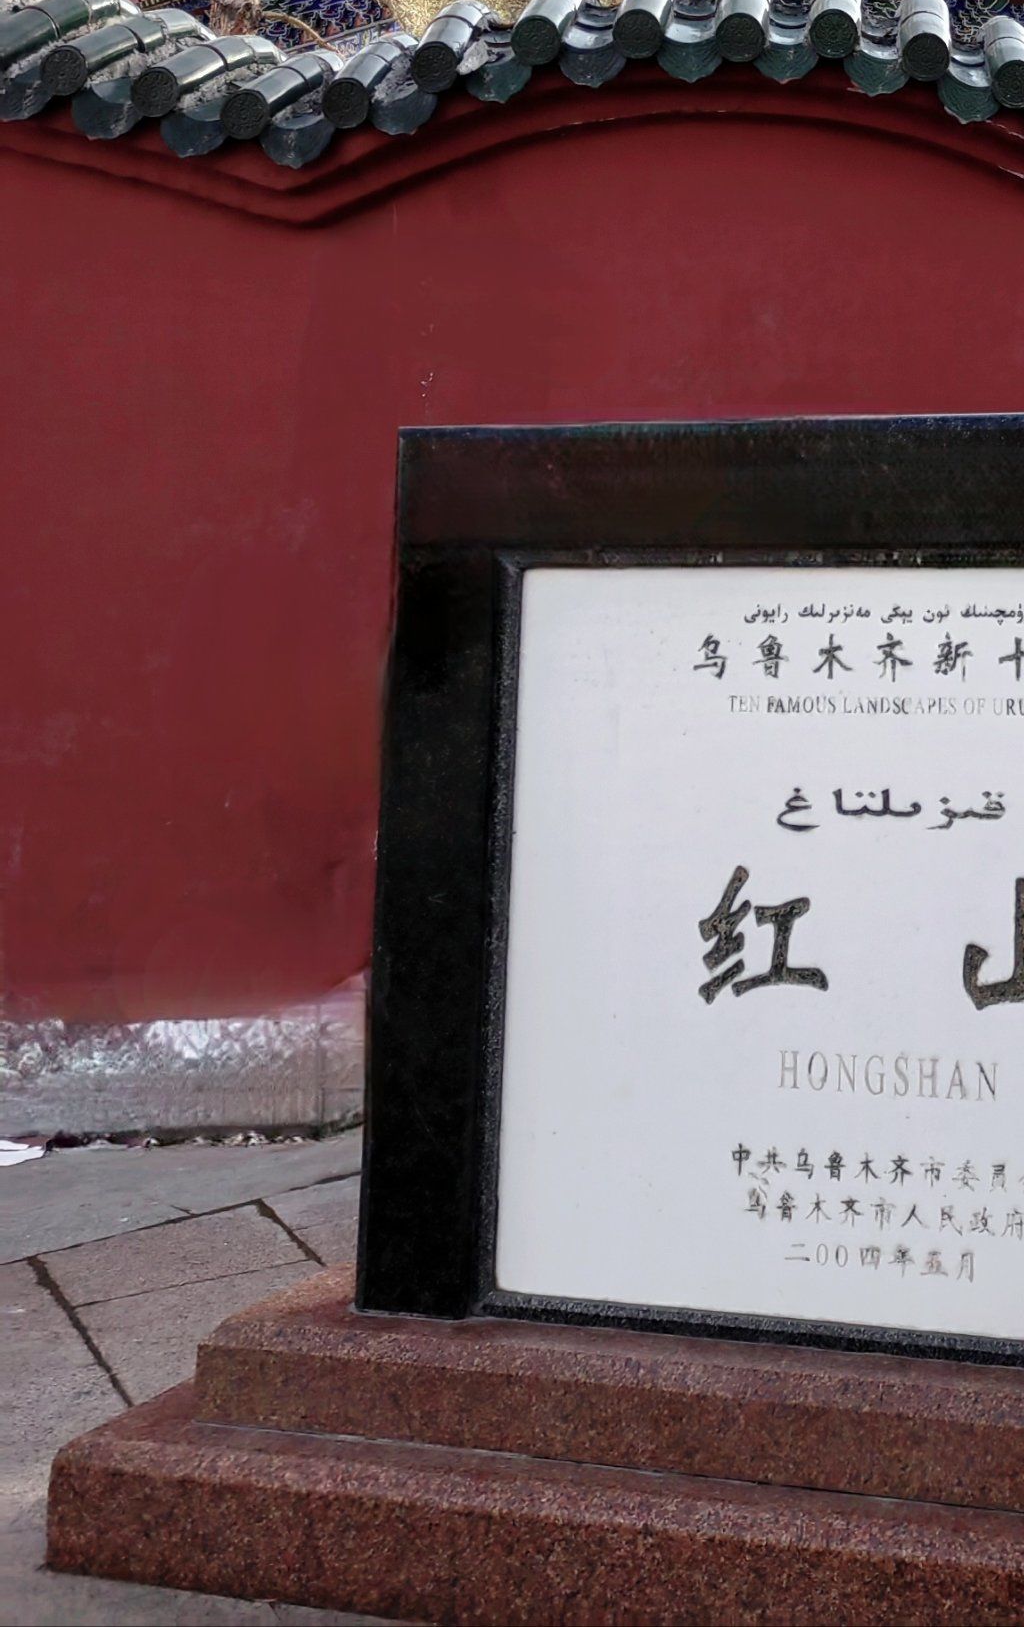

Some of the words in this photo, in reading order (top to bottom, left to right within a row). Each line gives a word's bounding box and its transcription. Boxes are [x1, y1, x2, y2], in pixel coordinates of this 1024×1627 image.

[728, 694, 761, 714] TEN
[767, 695, 837, 715] FAMOUS
[842, 695, 958, 716] LANDSCAPES
[963, 696, 987, 716] OF
[777, 1049, 999, 1102] HONGSHAN
